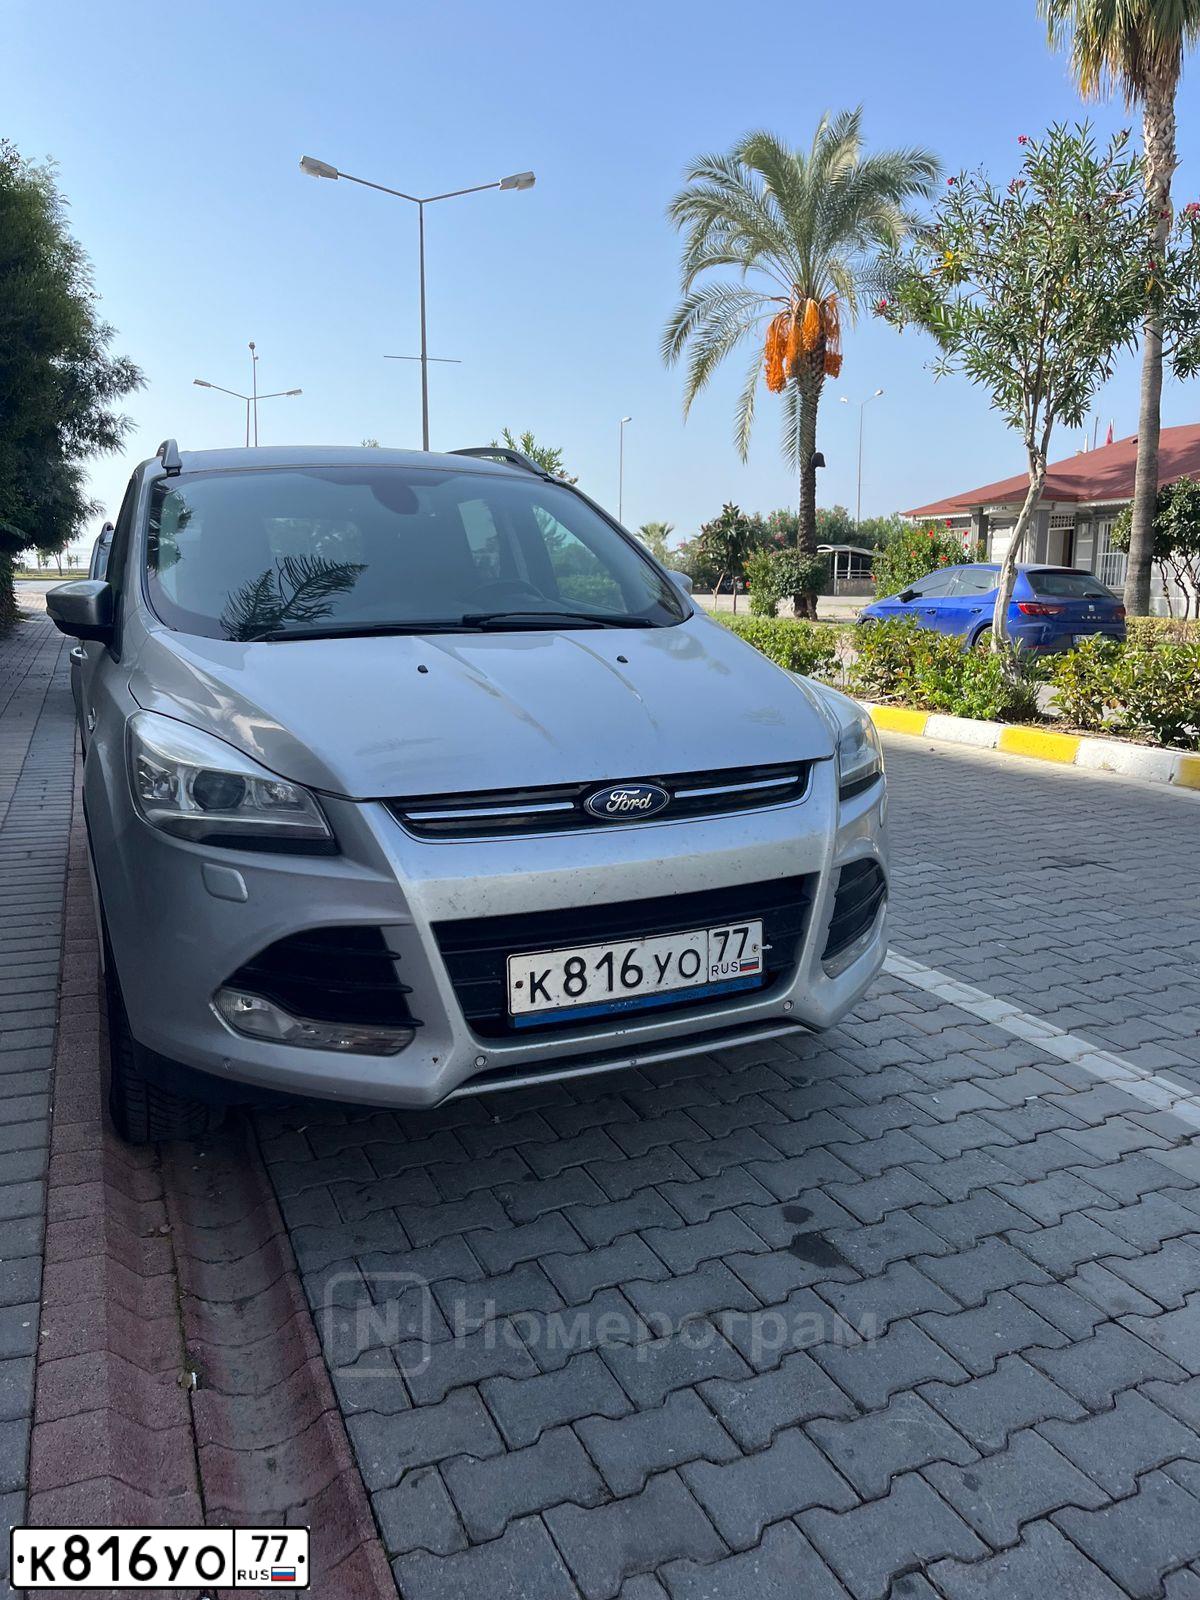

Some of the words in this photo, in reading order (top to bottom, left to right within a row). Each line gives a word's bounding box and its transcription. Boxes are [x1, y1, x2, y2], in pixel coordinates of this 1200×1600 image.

[606, 789, 652, 812] Ford
[713, 927, 749, 962] 77
[711, 960, 739, 976] RUS
